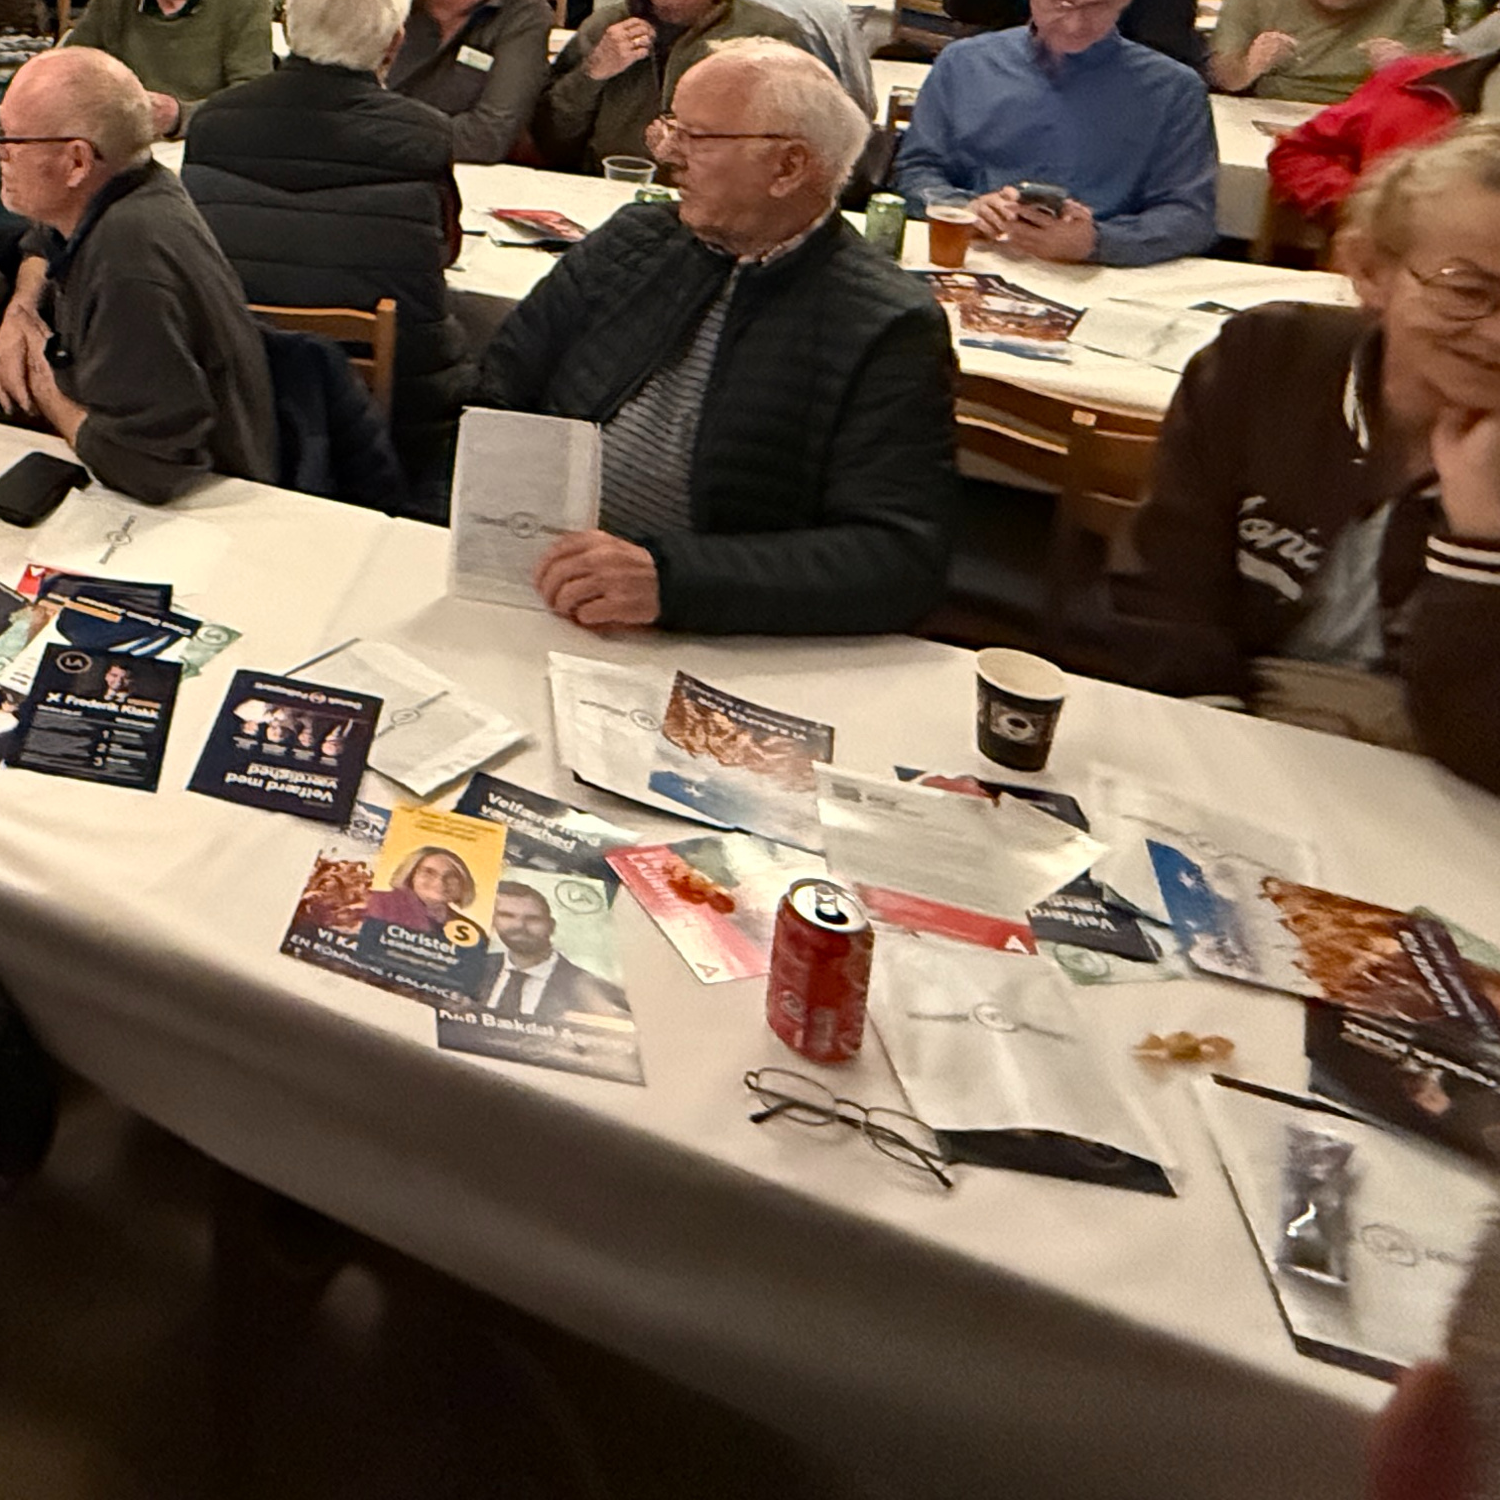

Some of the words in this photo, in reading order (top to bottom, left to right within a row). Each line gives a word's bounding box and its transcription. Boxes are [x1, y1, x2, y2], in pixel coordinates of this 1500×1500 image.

[224, 771, 264, 789] med
[265, 779, 334, 803] Velfærd
[487, 791, 560, 829] Velfærd
[386, 924, 457, 956] Christel
[480, 1012, 556, 1038] Bækdal
